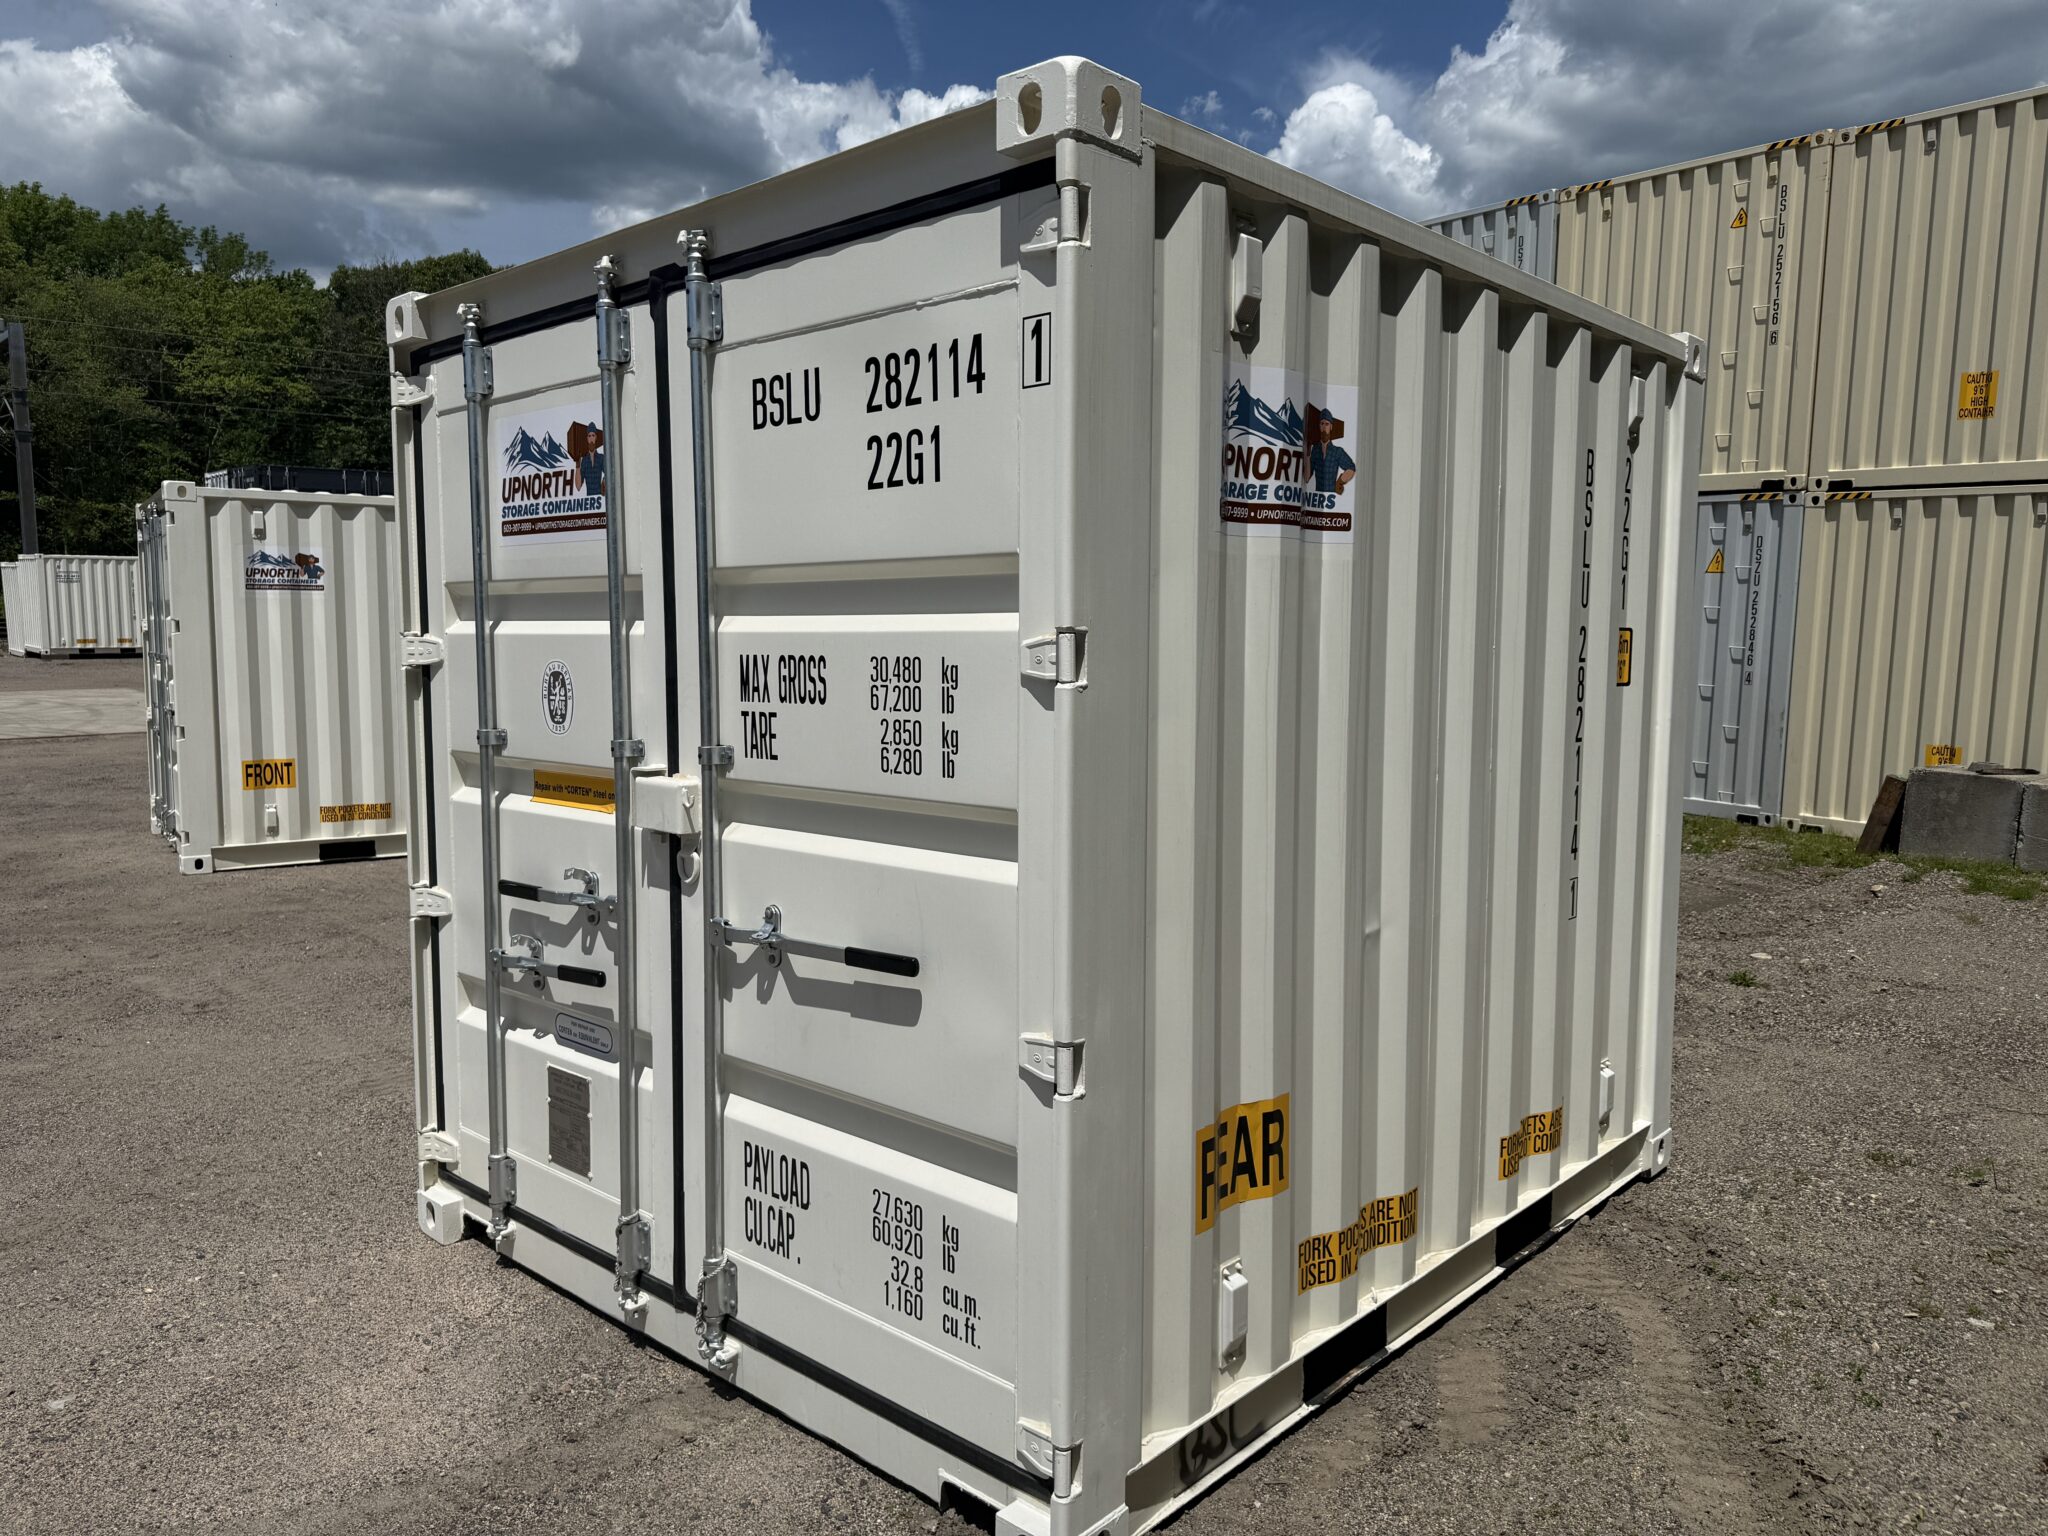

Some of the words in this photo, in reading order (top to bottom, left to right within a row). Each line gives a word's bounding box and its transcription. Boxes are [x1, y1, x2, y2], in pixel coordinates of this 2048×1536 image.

[1777, 184, 1788, 239] BSLU
[1771, 244, 1784, 325] 252156
[752, 367, 821, 430] BSLU
[865, 333, 986, 413] 282114
[867, 425, 941, 490] 22G1
[1222, 443, 1304, 483] PNORT
[502, 469, 575, 504] UPNORTH
[502, 503, 540, 519] STORAGE
[542, 496, 602, 515] CONTAINERS
[1223, 482, 1269, 501] RAGE
[1274, 485, 1336, 510] CONNERS
[535, 516, 607, 530] UPNORTHSTORAGECONTAINERS.CO
[1580, 448, 1594, 609] BSLU
[1620, 457, 1632, 610] 22G1
[246, 568, 299, 578] UPNORTH
[1753, 536, 1763, 586] DSZU
[1747, 591, 1759, 666] 252846
[740, 654, 770, 703] MAX
[778, 654, 827, 705] GROSS
[870, 656, 922, 684] 30,480
[942, 656, 959, 690] kg
[870, 684, 922, 713] 67,200
[942, 686, 955, 714] lb
[741, 711, 778, 760] TARE
[880, 719, 922, 747] 2,850
[942, 721, 959, 755] kg
[1570, 625, 1587, 861] 282114
[245, 762, 293, 787] FRONT
[881, 747, 922, 775] 6,280
[942, 751, 955, 779] lb
[320, 806, 336, 815] FORK
[366, 803, 379, 812] ARE
[380, 803, 391, 812] NOT
[535, 781, 551, 792] Repair
[552, 783, 563, 792] with
[565, 785, 592, 797] "CORTEN"
[593, 789, 606, 799] steel
[322, 814, 339, 823] USED
[358, 811, 391, 820] CONDITION
[744, 1141, 811, 1210] PAYLOAD
[872, 1188, 923, 1232] 27,630
[942, 1215, 959, 1252] kg
[872, 1216, 923, 1260] 60,920
[942, 1244, 956, 1274] lb
[1298, 1234, 1333, 1269] FORK
[1369, 1198, 1394, 1226] ARE
[1399, 1187, 1418, 1219] NOT
[891, 1256, 923, 1293] 32.8
[942, 1285, 982, 1320] cu.m.
[1301, 1259, 1336, 1291] USED
[1341, 1251, 1351, 1279] IN
[884, 1280, 923, 1321] 1,160
[942, 1314, 982, 1349] cu.ft.
